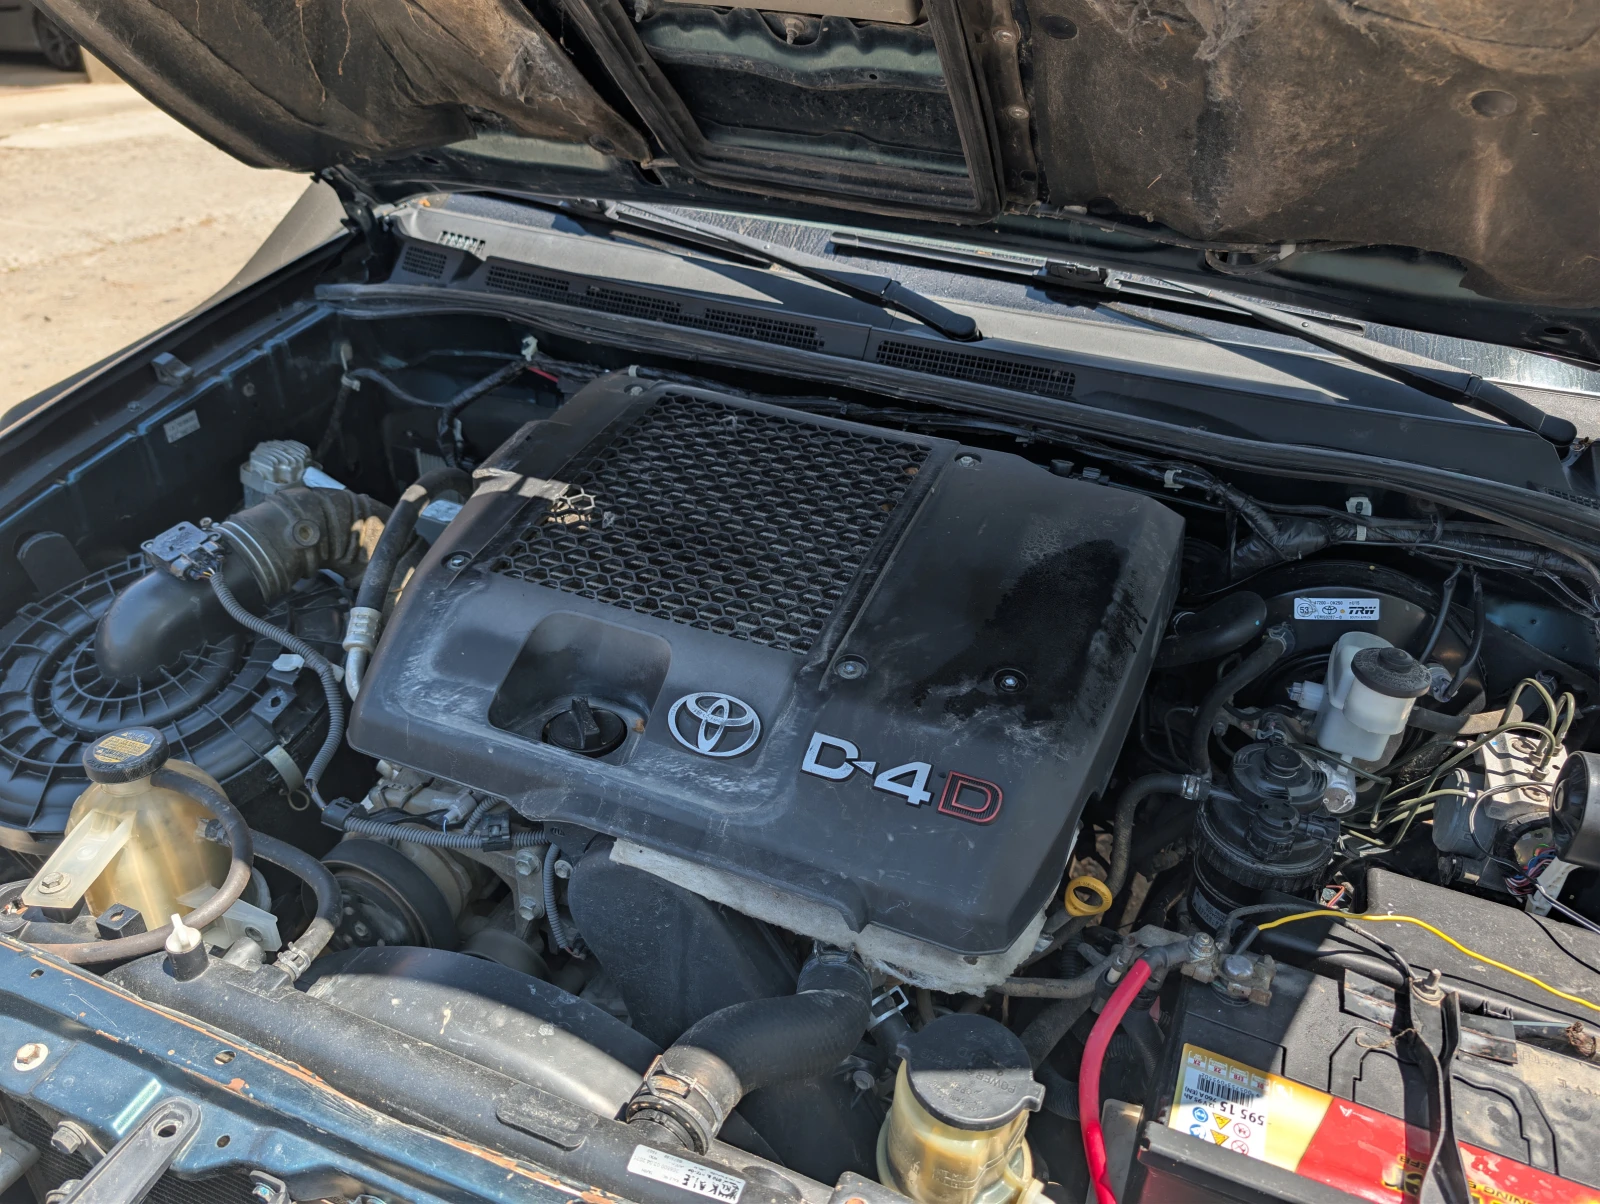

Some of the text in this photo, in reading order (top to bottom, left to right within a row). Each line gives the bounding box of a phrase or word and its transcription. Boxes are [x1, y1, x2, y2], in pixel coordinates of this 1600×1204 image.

[1299, 606, 1309, 614] 53
[1348, 606, 1376, 615] TRW
[976, 1071, 1016, 1094] POWER
[1220, 1101, 1265, 1126] 595 15
